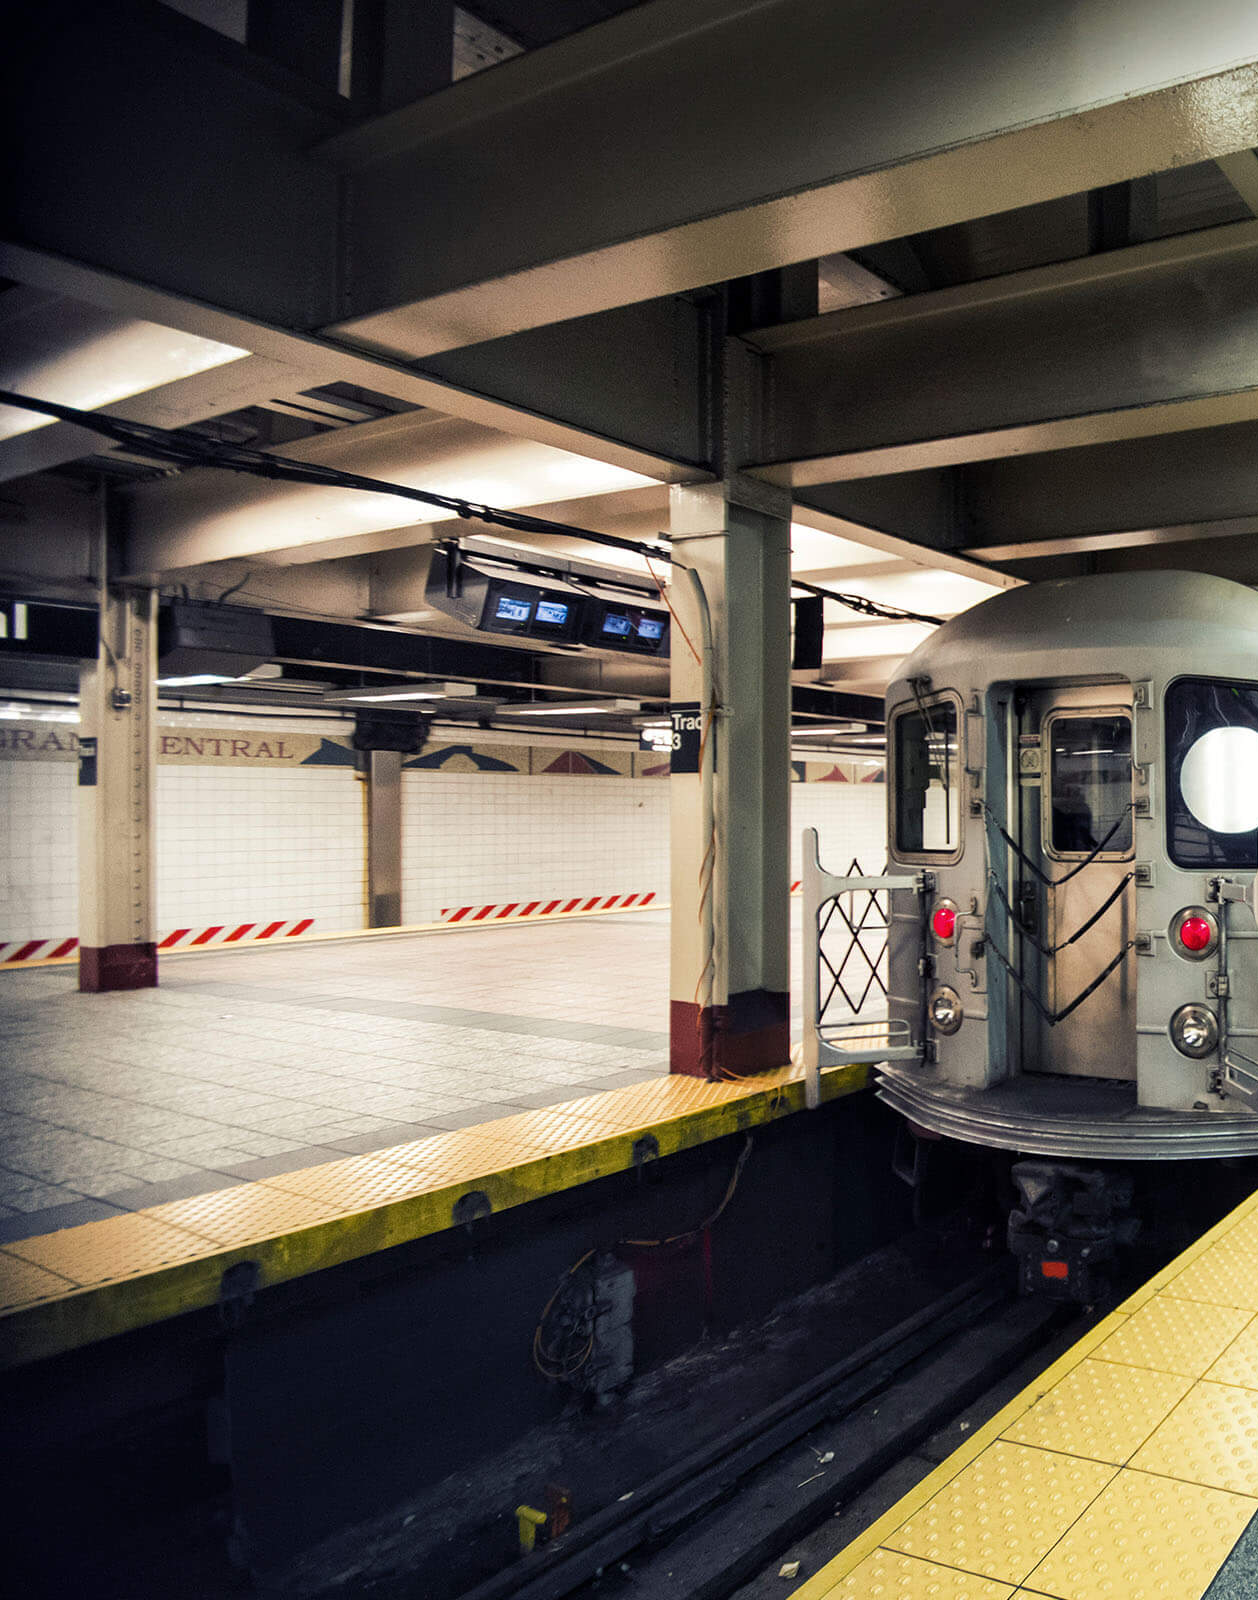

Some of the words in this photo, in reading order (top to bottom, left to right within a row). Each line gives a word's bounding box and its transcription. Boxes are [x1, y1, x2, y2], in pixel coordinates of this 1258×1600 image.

[671, 714, 703, 731] Trac
[160, 736, 294, 759] ENTRAL
[672, 733, 681, 750] 3
